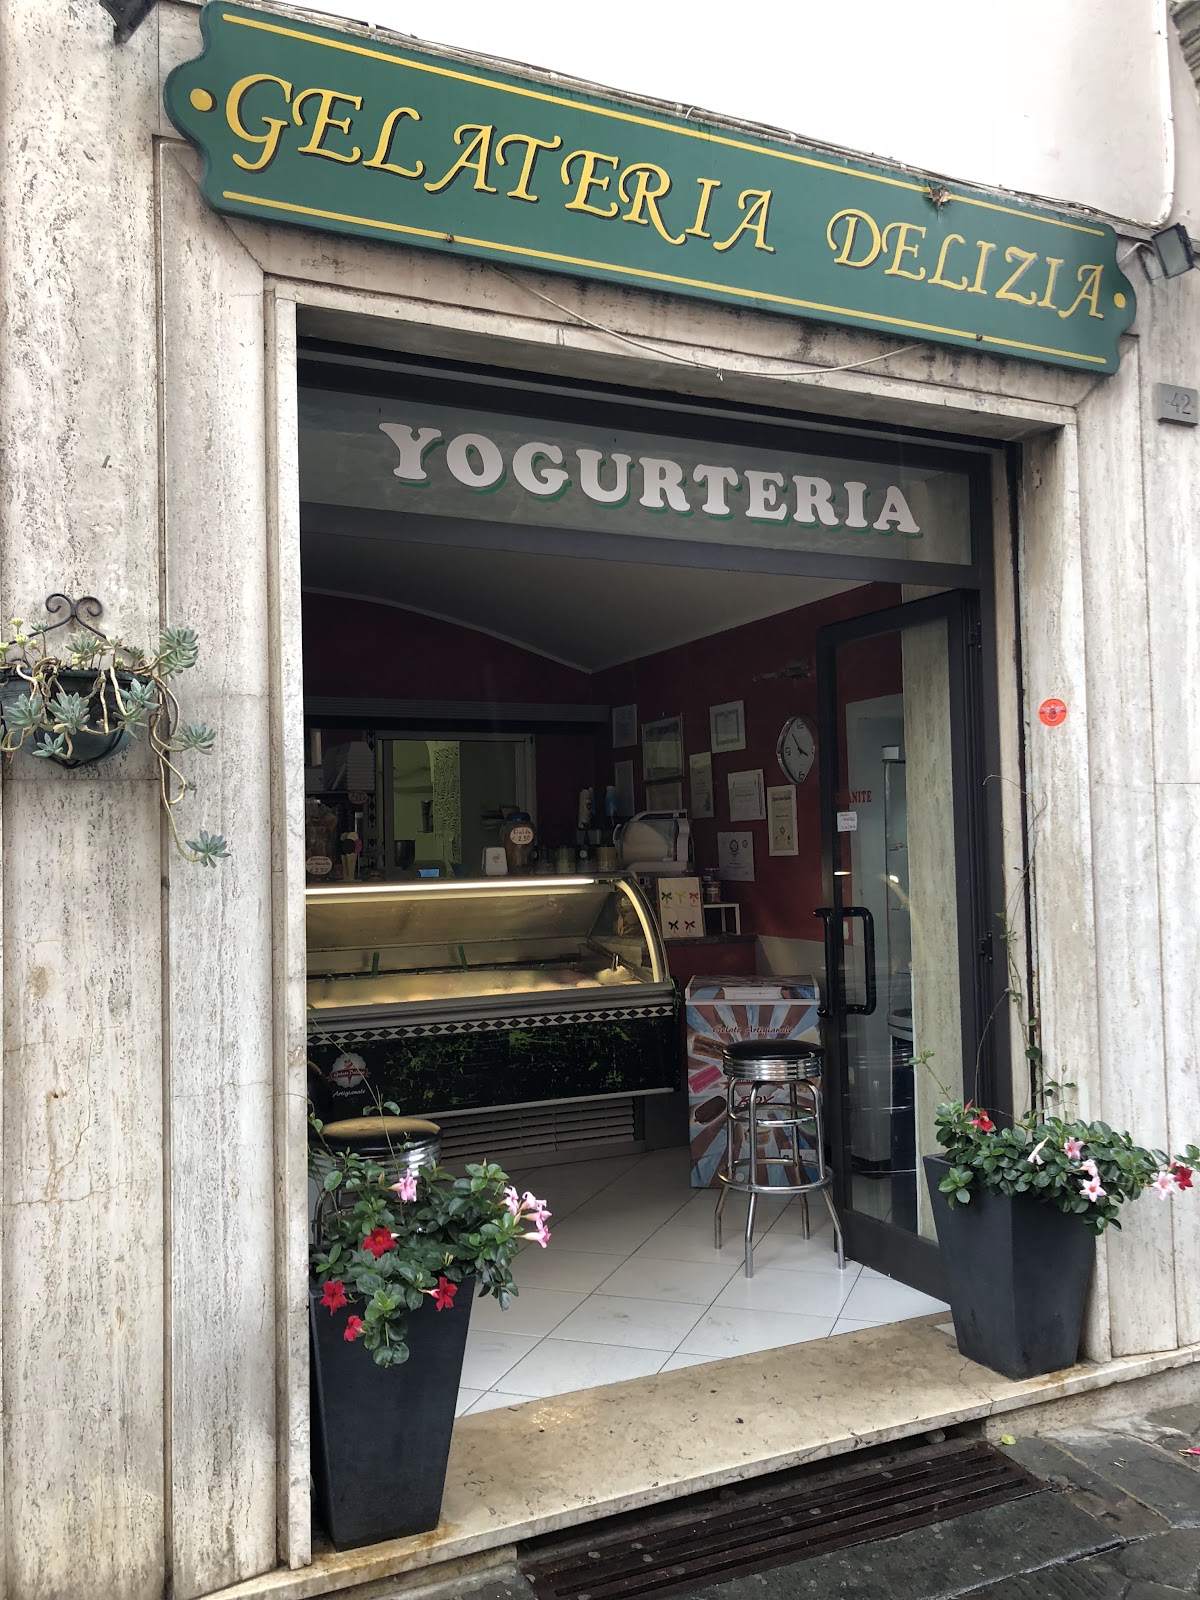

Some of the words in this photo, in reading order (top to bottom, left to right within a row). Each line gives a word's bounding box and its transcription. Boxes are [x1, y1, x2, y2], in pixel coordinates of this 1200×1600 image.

[225, 73, 775, 253] GELATERIA
[826, 208, 1105, 320] DELIZIA
[1170, 392, 1191, 415] 42
[378, 422, 921, 535] YOGURTERIA
[712, 1024, 741, 1034] Gelato
